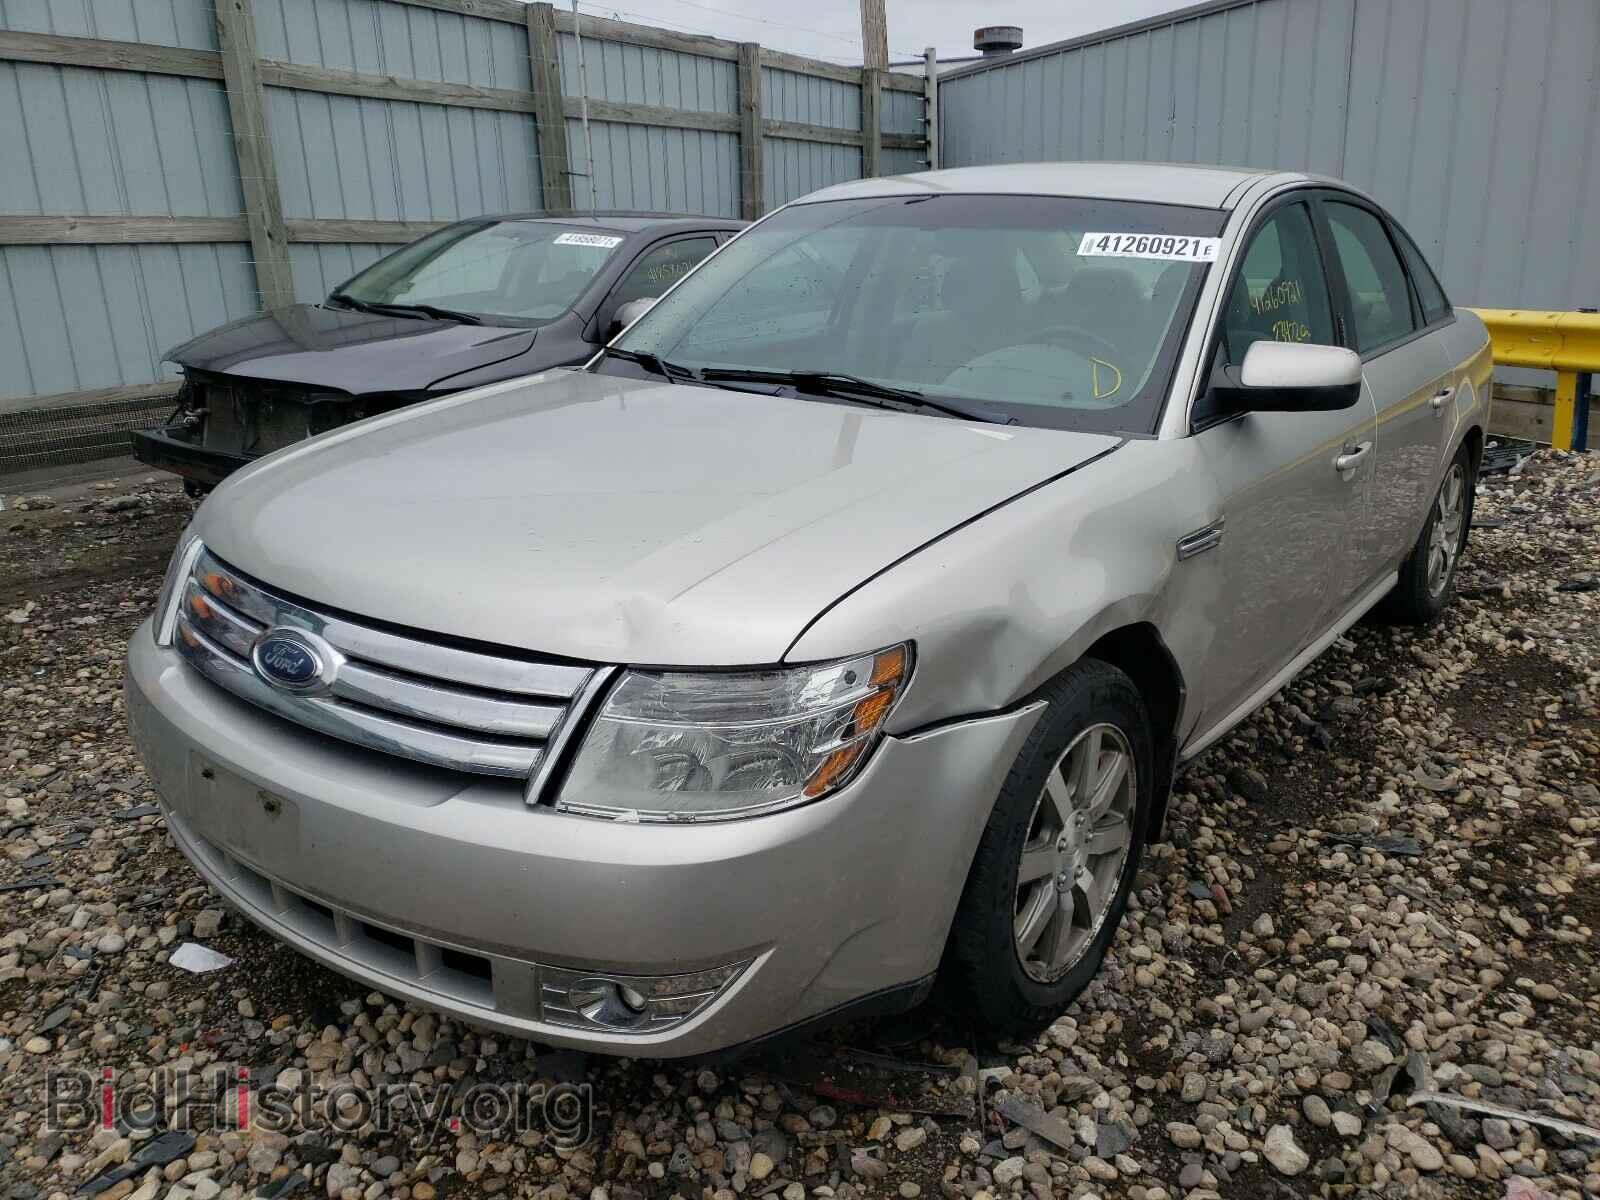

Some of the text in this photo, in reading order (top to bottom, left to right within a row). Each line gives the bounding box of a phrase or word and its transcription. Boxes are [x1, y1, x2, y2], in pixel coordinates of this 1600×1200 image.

[1096, 234, 1213, 257] 41260921 E
[1090, 357, 1122, 400] D
[264, 643, 305, 674] Ford
